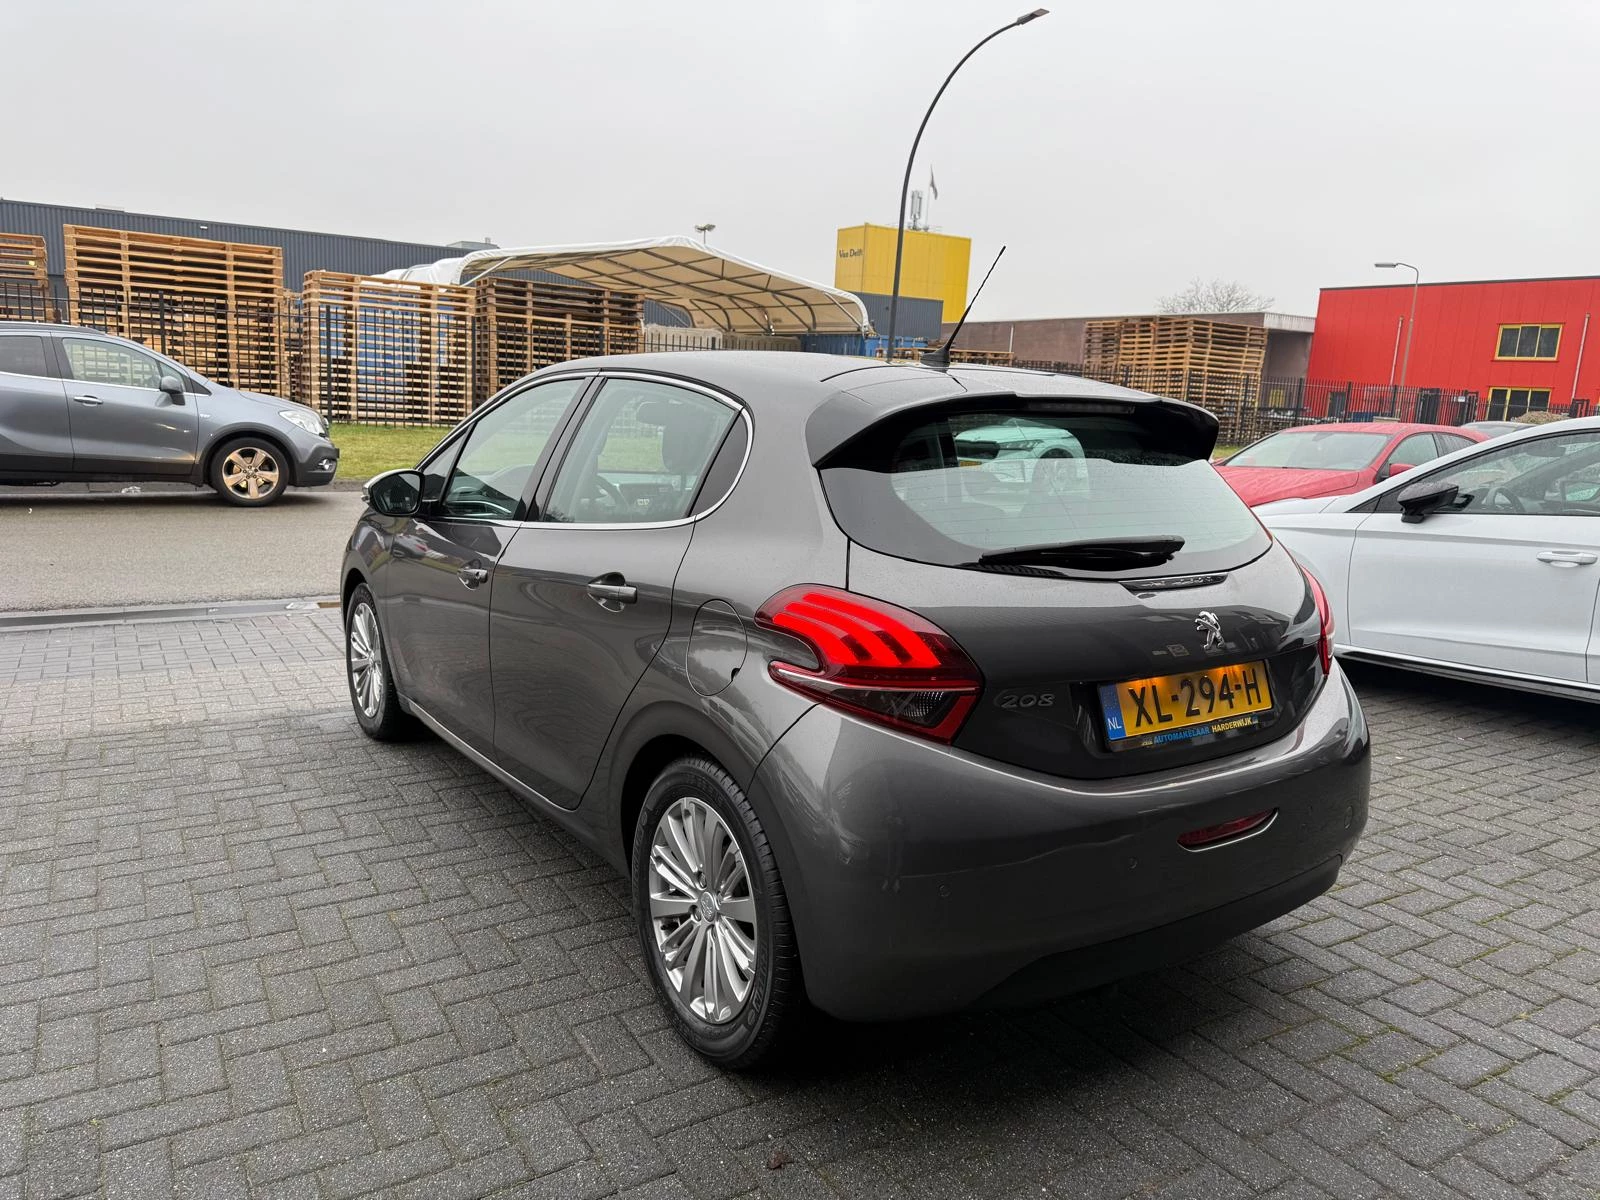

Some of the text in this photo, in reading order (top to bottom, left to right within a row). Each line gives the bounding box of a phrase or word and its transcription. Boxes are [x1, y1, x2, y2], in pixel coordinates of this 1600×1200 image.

[1001, 693, 1055, 708] 208
[1128, 668, 1262, 728] XL-294-H
[1107, 717, 1122, 730] NL
[1153, 717, 1253, 745] AUTOMAKELAAR HARDERWIJK
